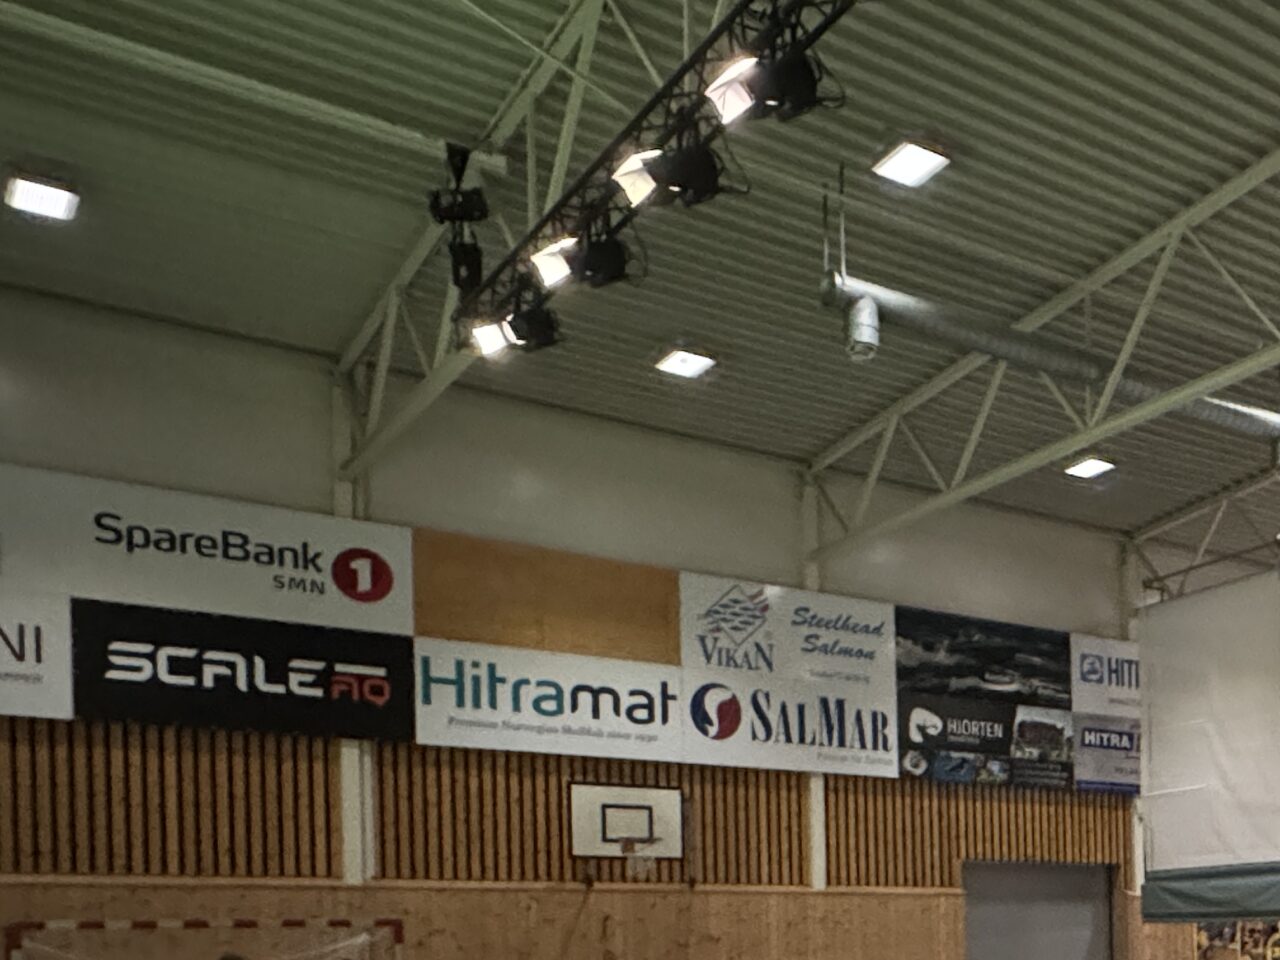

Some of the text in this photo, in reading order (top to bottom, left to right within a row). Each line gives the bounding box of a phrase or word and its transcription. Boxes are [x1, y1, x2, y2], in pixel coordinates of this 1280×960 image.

[93, 511, 373, 595] SpareBank 1
[272, 575, 326, 595] SMN
[790, 606, 885, 637] Steelhead
[696, 634, 774, 673] VIKAN
[801, 633, 876, 660] Salmon
[420, 655, 678, 726] Hitramat
[946, 717, 1005, 738] HJORTEN
[1083, 730, 1131, 749] HITRA
